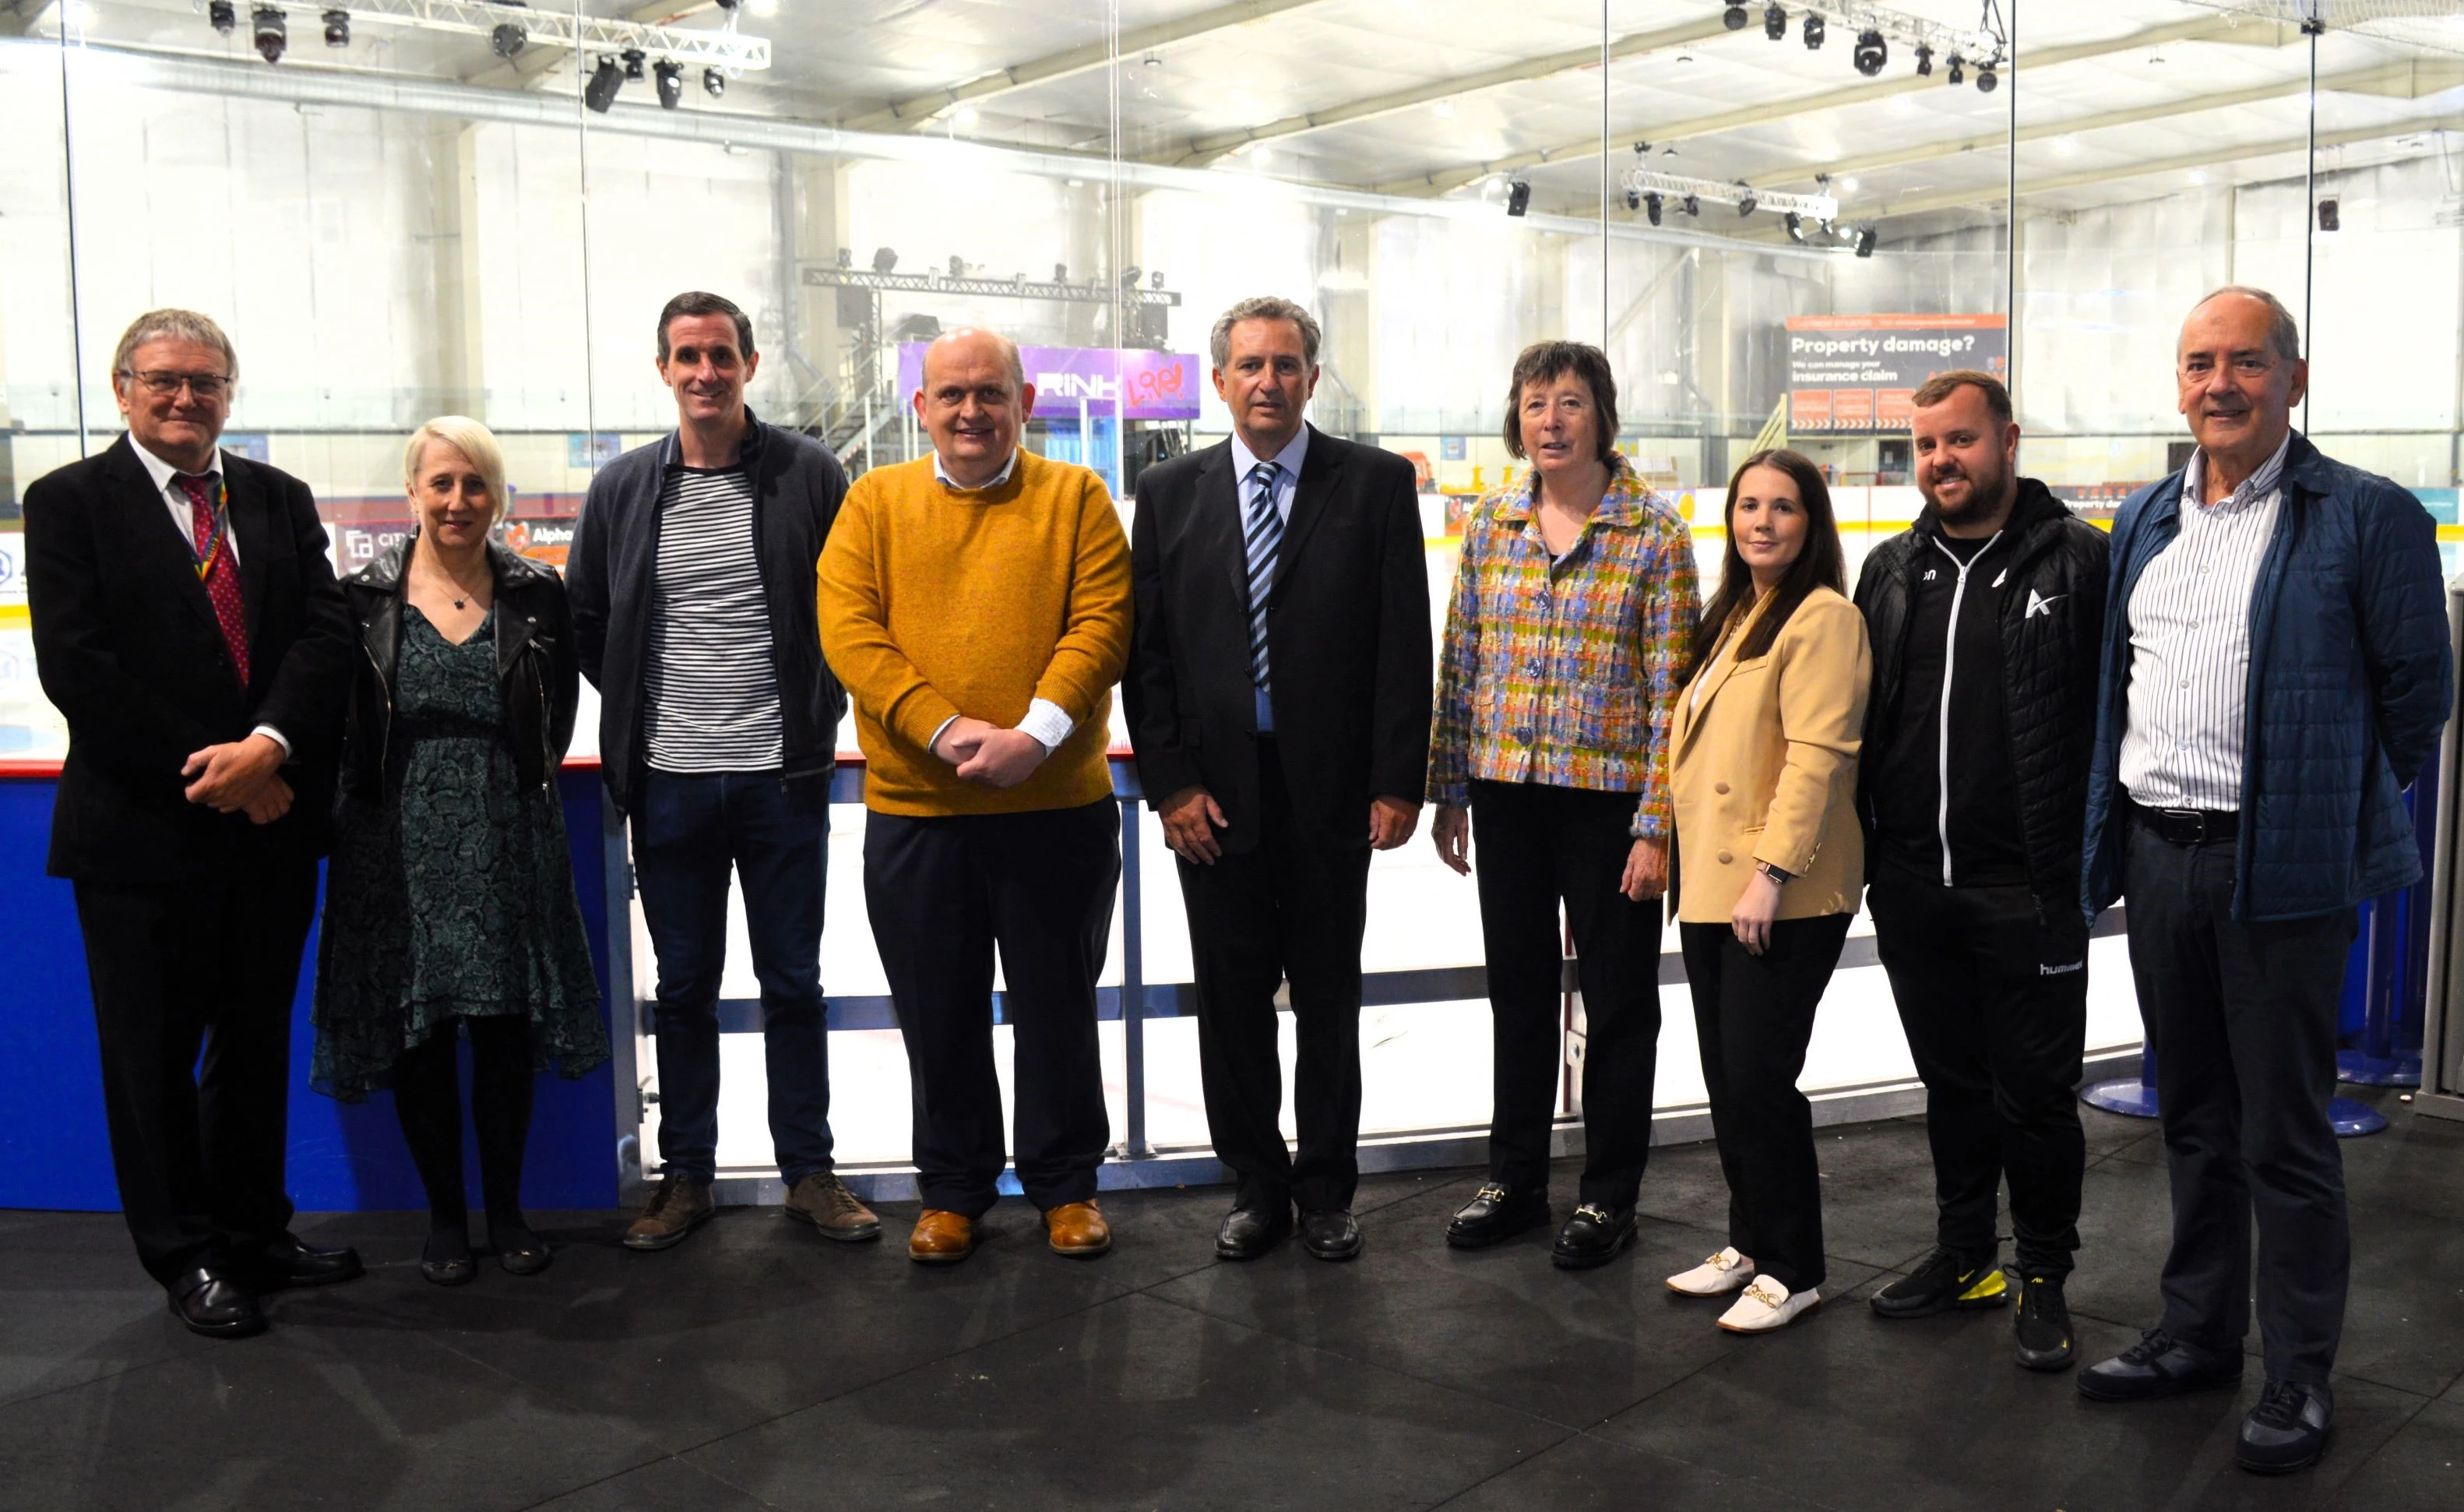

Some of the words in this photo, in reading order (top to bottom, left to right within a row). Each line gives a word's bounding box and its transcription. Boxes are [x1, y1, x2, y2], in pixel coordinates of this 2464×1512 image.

[1792, 337, 1879, 357] Property
[1883, 336, 1975, 357] damage?
[1792, 361, 1806, 369] We
[1825, 361, 1860, 370] manage
[1861, 361, 1881, 370] your
[1792, 370, 1859, 382] insurance
[1860, 369, 1898, 382] claim
[532, 527, 575, 545] Alpha
